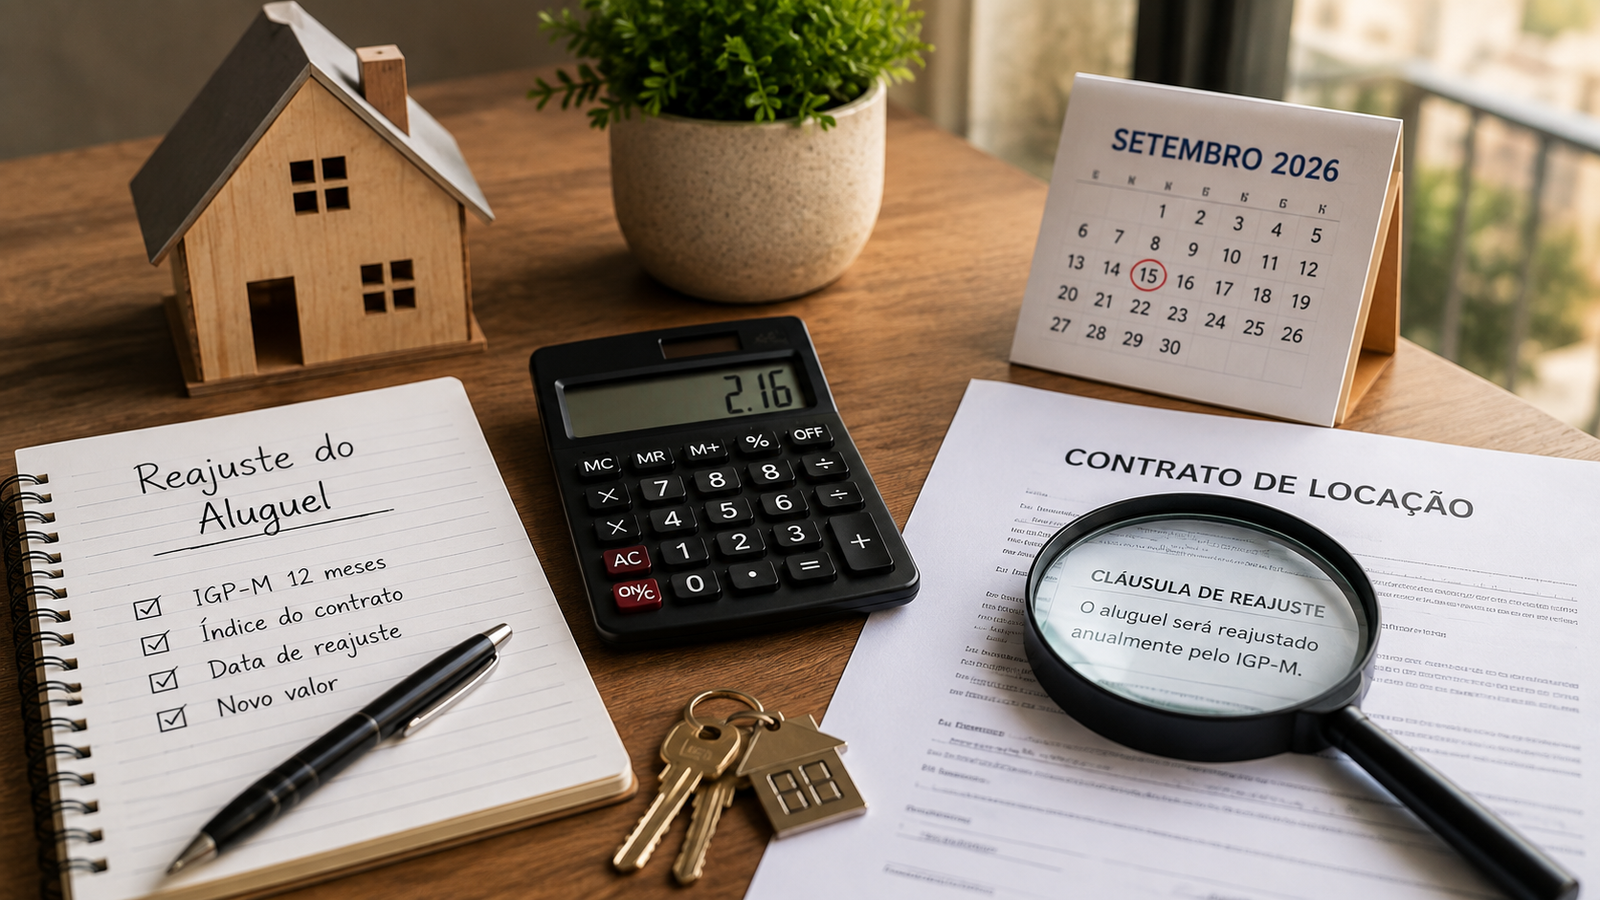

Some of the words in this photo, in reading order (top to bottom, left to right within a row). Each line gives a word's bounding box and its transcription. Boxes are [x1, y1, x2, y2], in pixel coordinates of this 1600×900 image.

[1111, 127, 1263, 171] SETEMBRO
[1270, 151, 1340, 183] 2026
[1159, 203, 1167, 219] 1
[1194, 209, 1207, 226] 2
[1232, 215, 1245, 232] 3
[1270, 222, 1282, 238] 4
[1310, 227, 1323, 244] 5
[1077, 223, 1089, 239] 6
[1114, 228, 1125, 244] 7
[1149, 235, 1161, 252] 8
[1187, 241, 1199, 257] 9
[1223, 247, 1242, 265] 10
[1262, 254, 1279, 271] 11
[1300, 260, 1319, 278] 12
[1068, 253, 1085, 271] 13
[1104, 260, 1121, 277] 14
[1140, 267, 1159, 284] 15
[1177, 274, 1195, 291] 16
[1215, 280, 1234, 297] 17
[1253, 286, 1272, 304] 18
[1292, 293, 1311, 310] 19
[1049, 315, 1072, 333] 27
[1085, 323, 1107, 341] 28
[1122, 330, 1144, 348] 29
[1159, 337, 1181, 356] 30
[1057, 284, 1079, 302] 20
[1093, 291, 1113, 309] 21
[1129, 298, 1151, 317] 22
[1166, 305, 1189, 323] 23
[1204, 312, 1226, 330] 24
[1242, 319, 1266, 337] 25
[1280, 326, 1304, 344] 26
[723, 369, 793, 415] 2.16
[133, 445, 294, 497] Reajuste
[315, 432, 354, 462] do
[583, 457, 614, 472] MC
[636, 450, 666, 465] MR
[689, 442, 720, 457] M+
[745, 433, 770, 449] %
[793, 426, 823, 441] OFF
[653, 479, 669, 497] 7
[708, 471, 726, 488] 8
[761, 464, 780, 480] 8
[1064, 448, 1242, 487] CONTRATO
[1253, 471, 1298, 495] DE
[1308, 478, 1474, 519] LOCAÇÃO
[198, 480, 332, 535] Aluguel
[664, 510, 682, 527] 4
[720, 501, 738, 519] 5
[775, 494, 793, 511] 6
[613, 551, 642, 568] AC
[675, 542, 690, 559] 1
[731, 533, 751, 551] 2
[787, 525, 806, 542] 3
[192, 574, 273, 607] IGP-M
[287, 567, 314, 587] 12
[324, 558, 387, 580] meses
[685, 574, 705, 593] 0
[1091, 569, 1191, 597] CLÁUSULA
[1197, 585, 1225, 602] DE
[1229, 591, 1326, 619] REAJUSTE
[200, 616, 268, 643] Índice
[278, 606, 303, 626] do
[314, 587, 403, 618] contrato
[1080, 600, 1095, 614] O
[1099, 604, 1168, 627] aluguel
[1172, 618, 1212, 634] será
[1218, 626, 1319, 652] reajustado
[207, 653, 266, 680] Data
[276, 644, 304, 664] de
[314, 623, 402, 659] reajuste
[1071, 630, 1184, 656] anualmente
[1187, 647, 1230, 664] pelo
[1236, 652, 1302, 677] IGP-M.
[216, 694, 273, 718] Novo
[284, 676, 338, 701] valor
